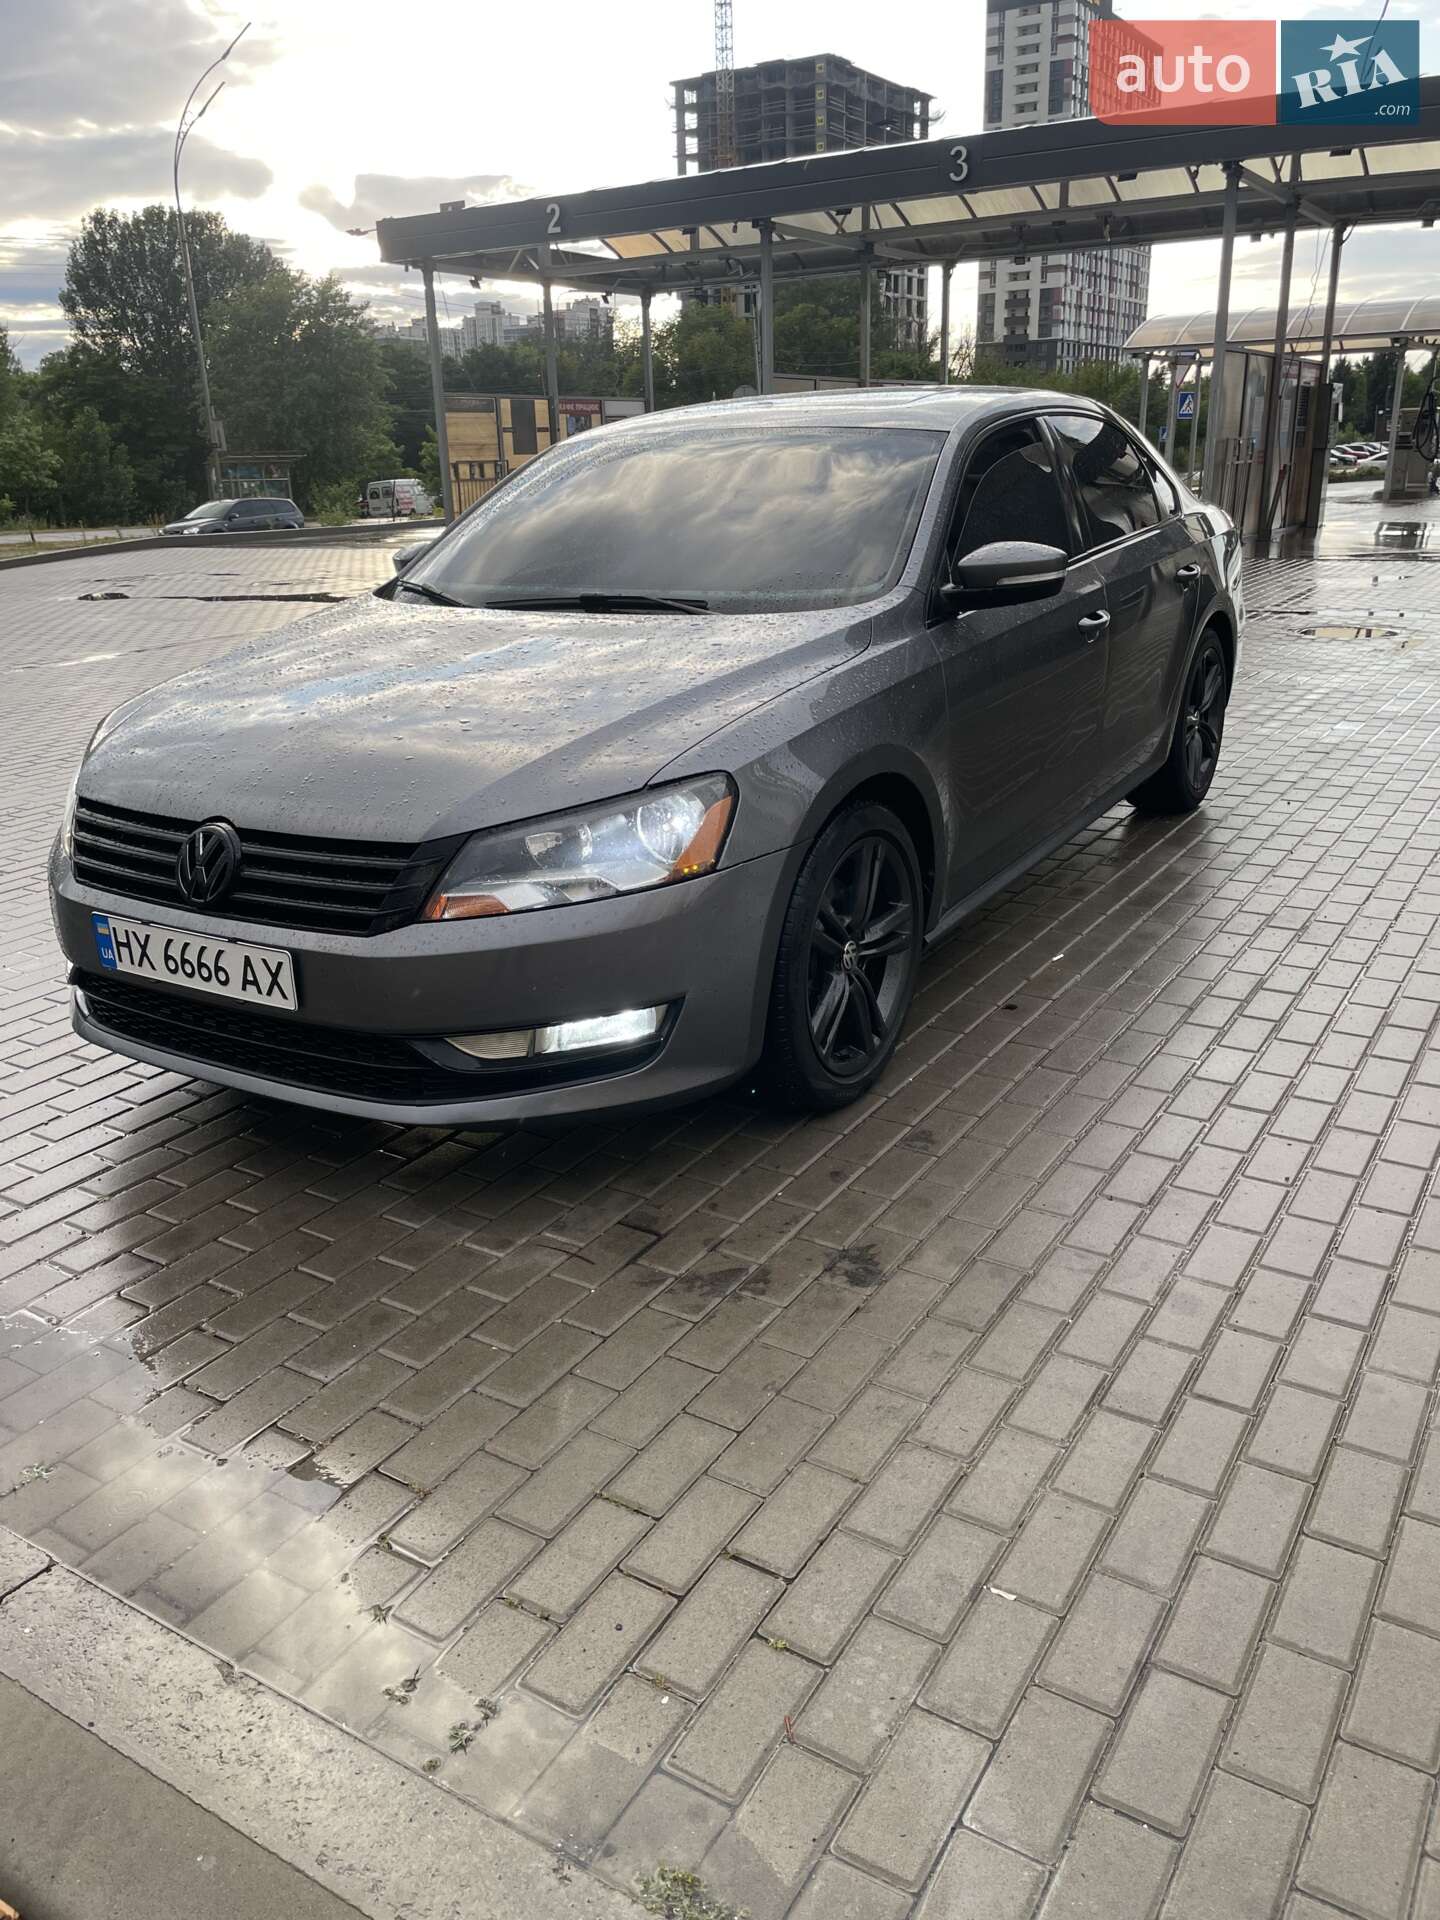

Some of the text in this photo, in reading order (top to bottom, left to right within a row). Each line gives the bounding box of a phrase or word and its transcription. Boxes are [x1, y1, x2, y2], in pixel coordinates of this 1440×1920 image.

[949, 145, 968, 182] 3
[546, 203, 561, 234] 2
[101, 946, 115, 961] UA
[112, 926, 289, 1001] HX 6666 AX
